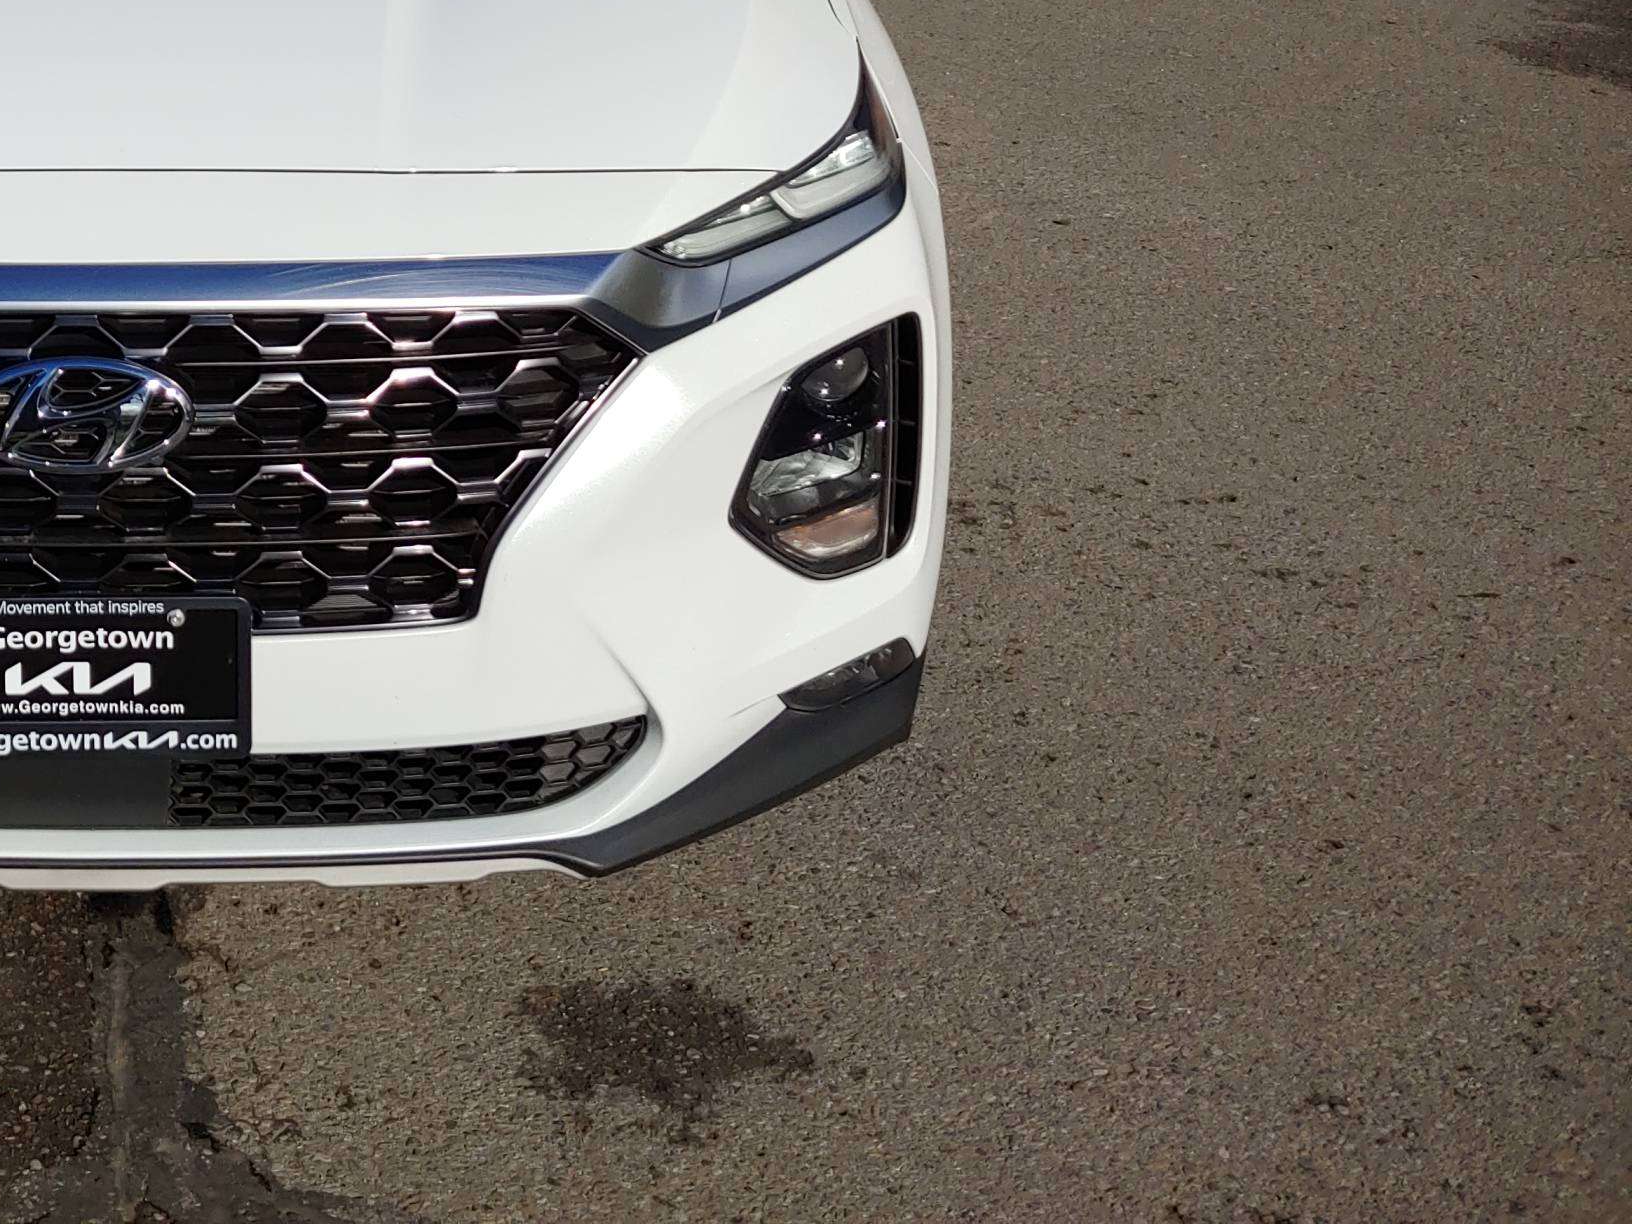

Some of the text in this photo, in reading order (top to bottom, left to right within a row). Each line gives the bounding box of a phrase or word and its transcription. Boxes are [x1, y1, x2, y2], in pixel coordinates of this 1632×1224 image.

[74, 601, 104, 615] that
[108, 601, 165, 617] inspires
[4, 661, 152, 696] KIA
